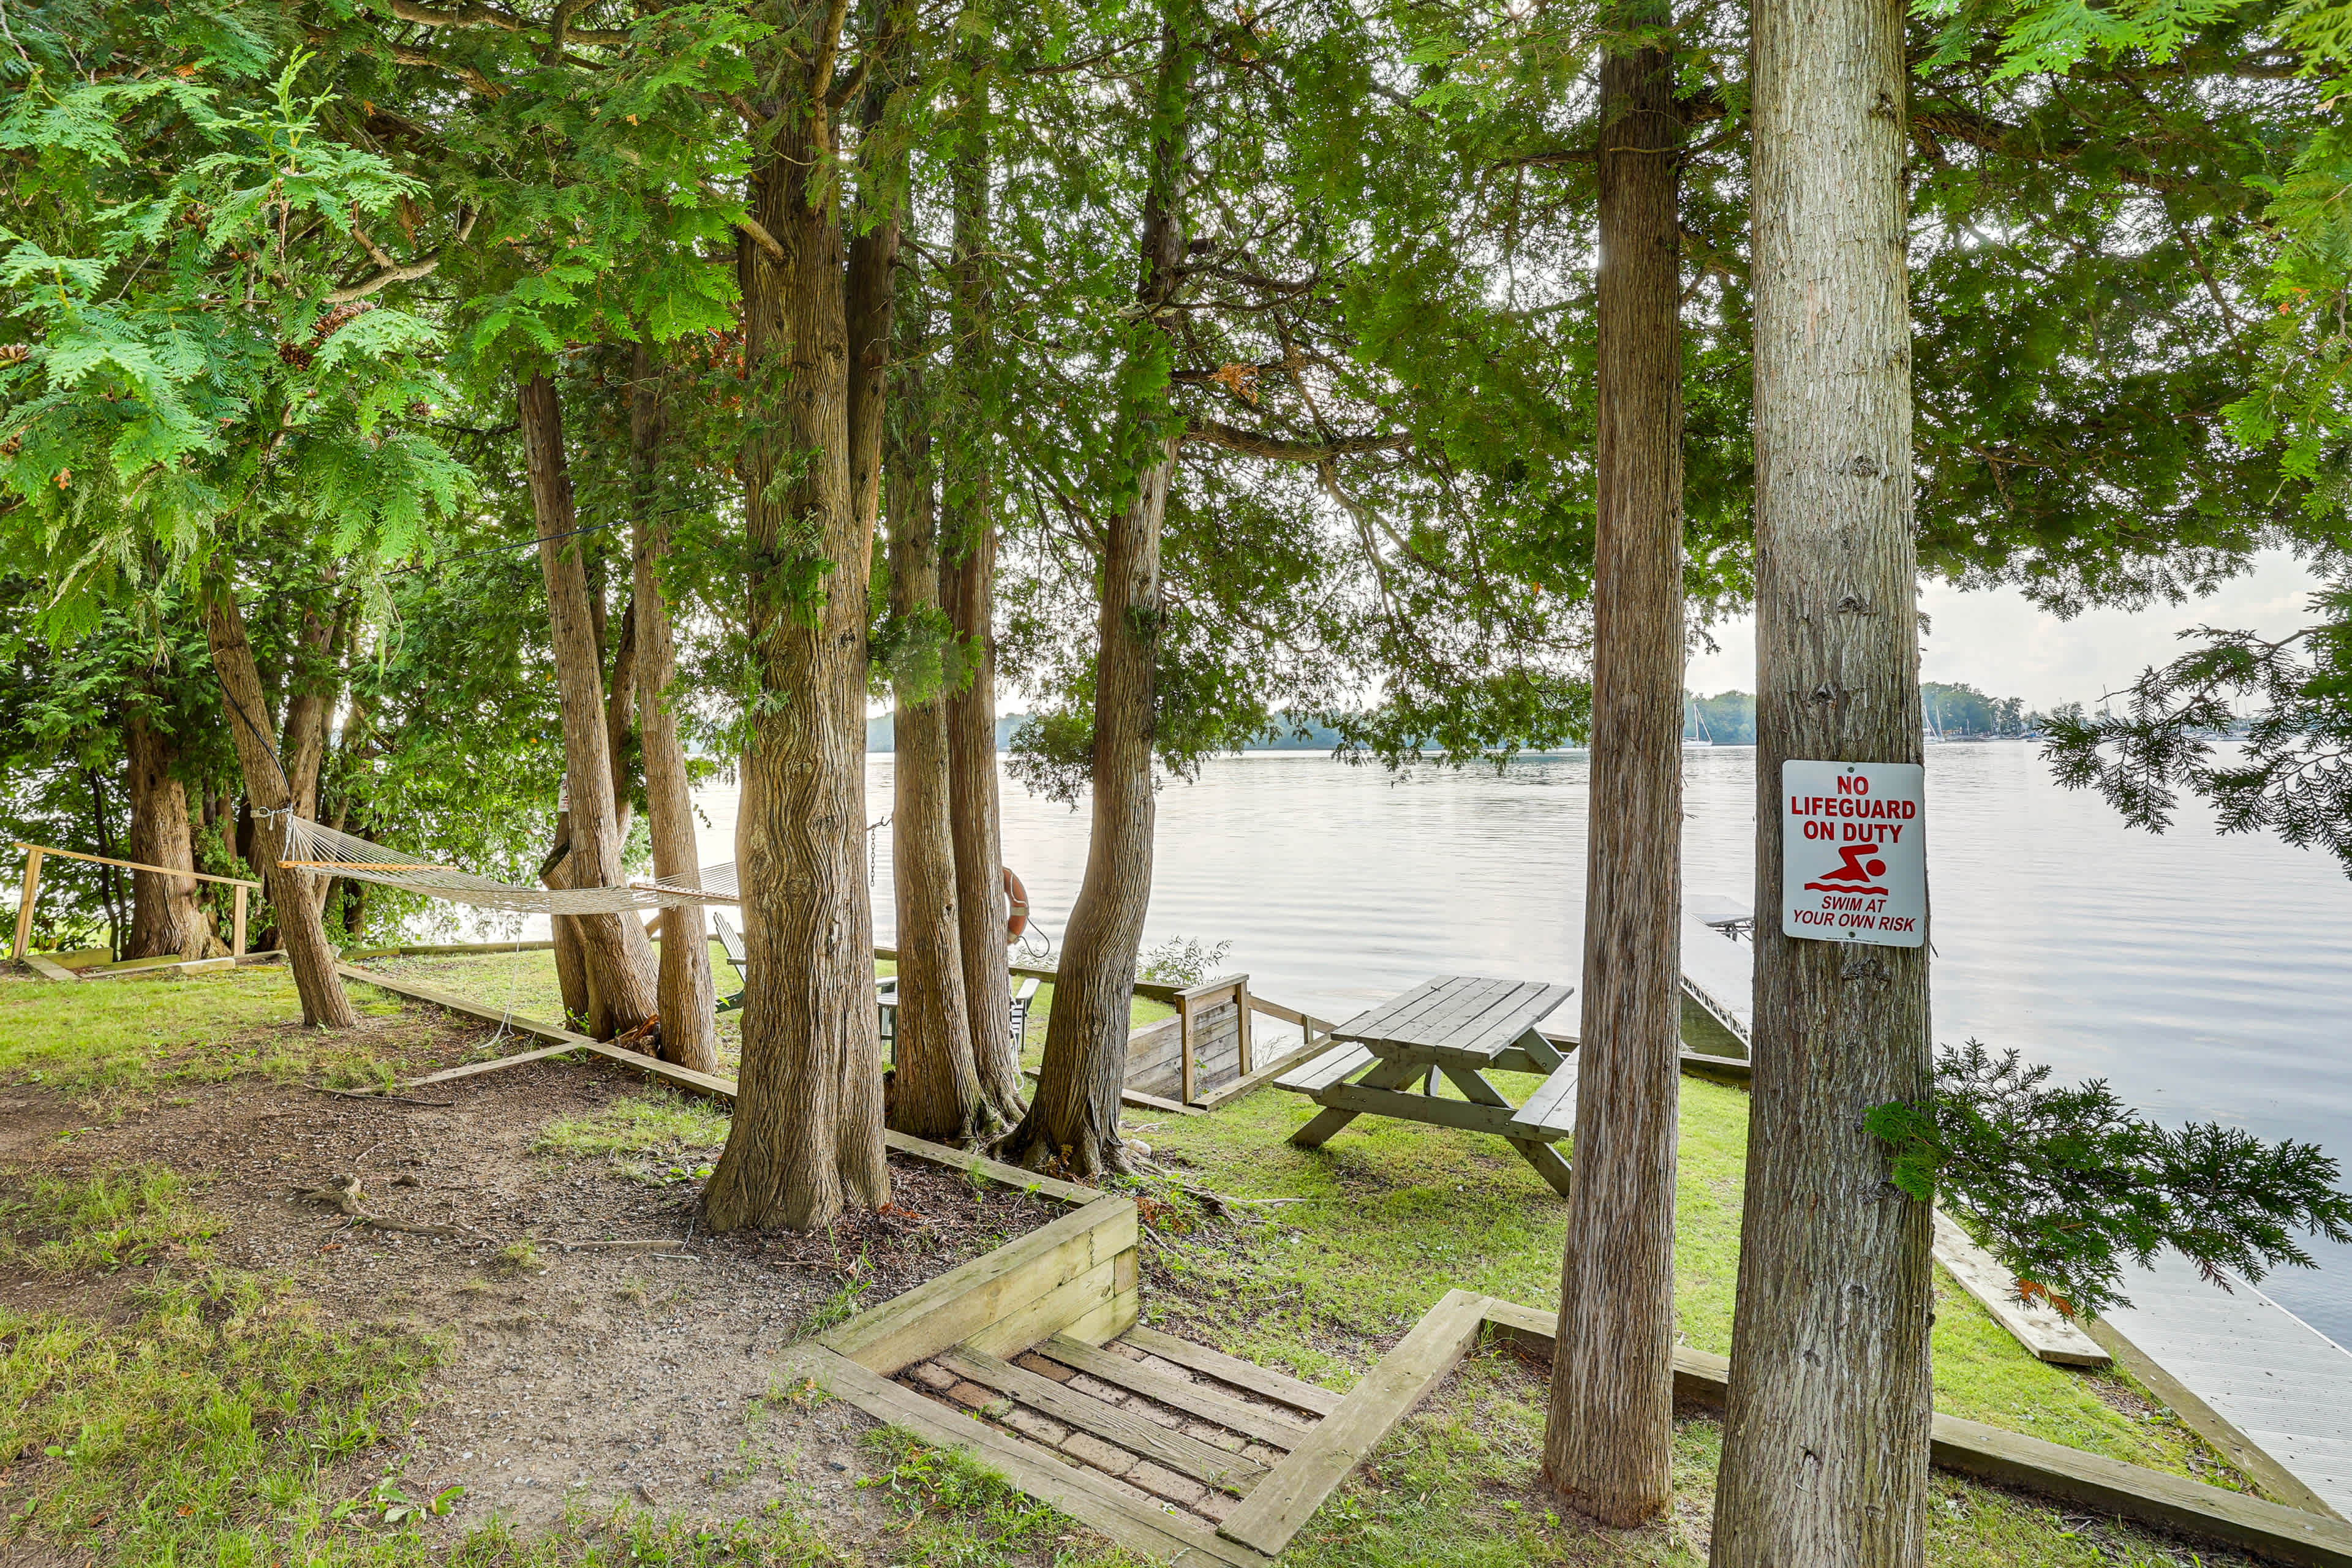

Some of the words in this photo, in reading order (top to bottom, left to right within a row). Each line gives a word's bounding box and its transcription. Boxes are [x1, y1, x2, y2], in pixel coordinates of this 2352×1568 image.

[1837, 775, 1869, 795] NO
[1791, 796, 1916, 819] LIFEGUARD
[1804, 820, 1834, 840] ON
[1843, 823, 1904, 843] DUTY
[1822, 895, 1863, 911] SWIM
[1865, 899, 1887, 913] AT
[1793, 910, 1834, 926] YOUR
[1838, 913, 1875, 929] OWN
[1879, 916, 1917, 932] RISK
